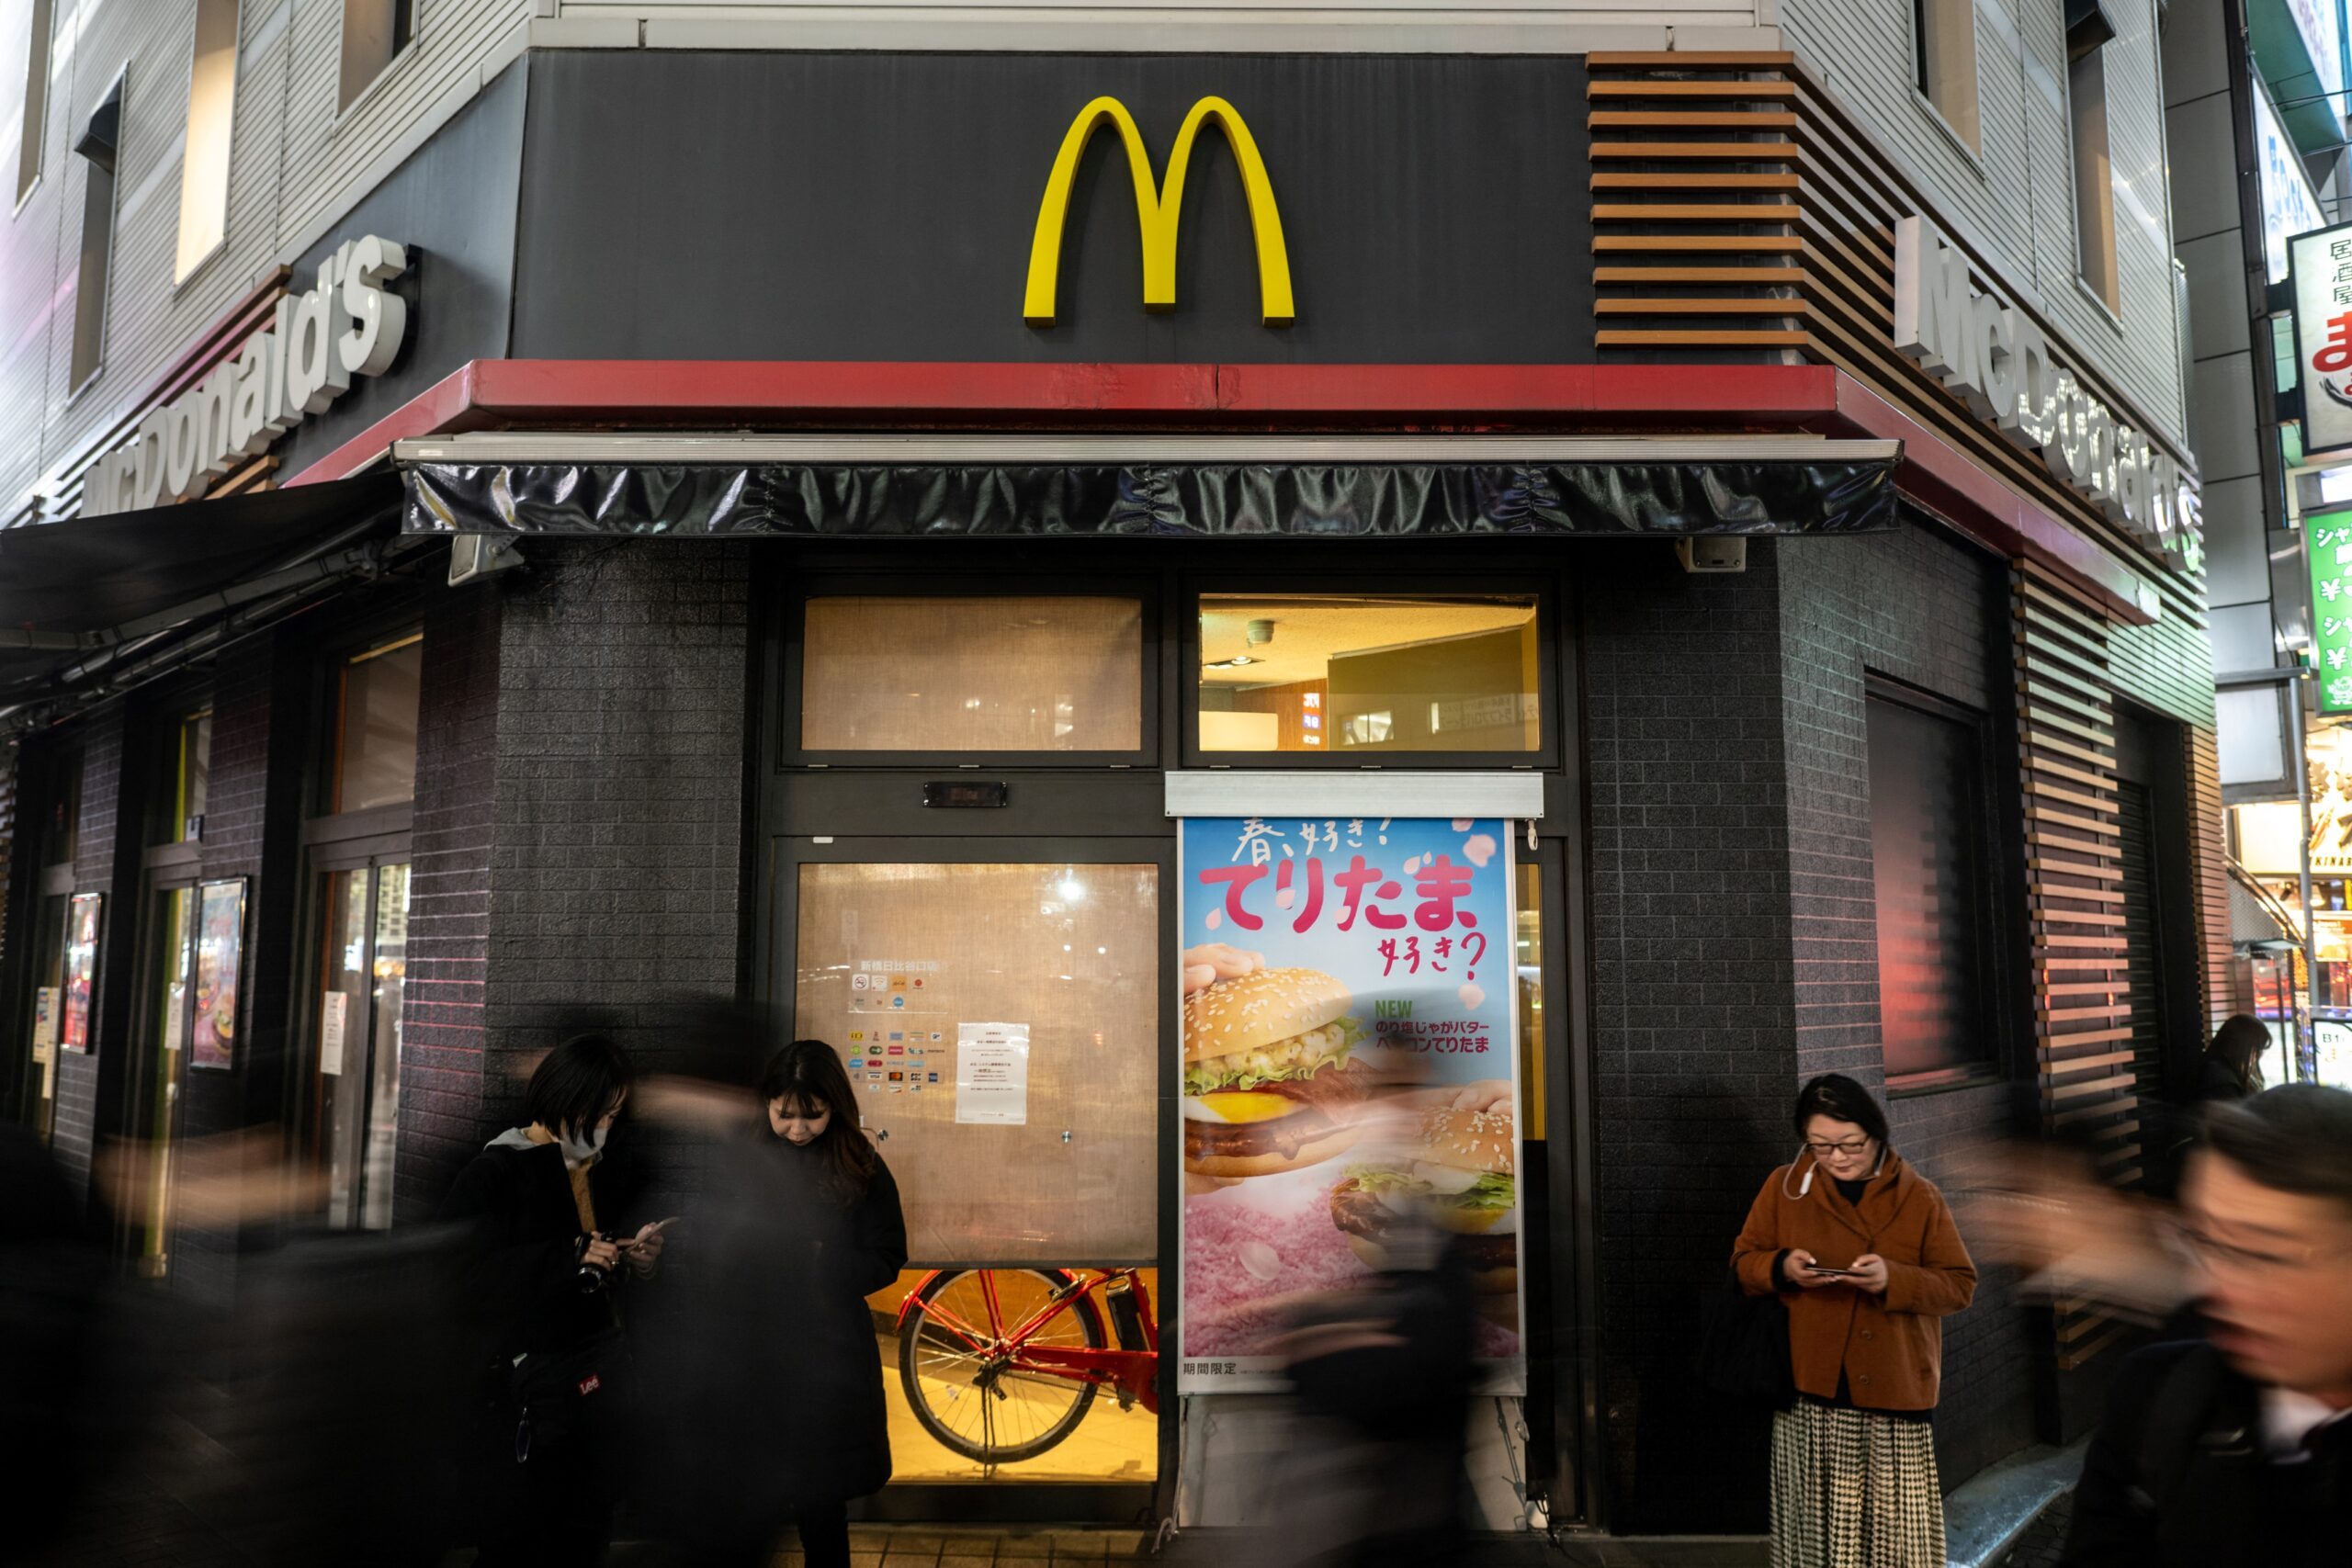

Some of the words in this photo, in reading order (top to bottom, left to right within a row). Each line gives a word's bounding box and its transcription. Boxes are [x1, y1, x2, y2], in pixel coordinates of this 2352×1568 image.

[2331, 239, 2352, 306] 居酒屋
[1374, 999, 1413, 1019] NEW
[1375, 1021, 1490, 1034] のり塩じゃがバター
[1183, 1362, 1237, 1376] 期間限定
[580, 1375, 599, 1394] Lee
